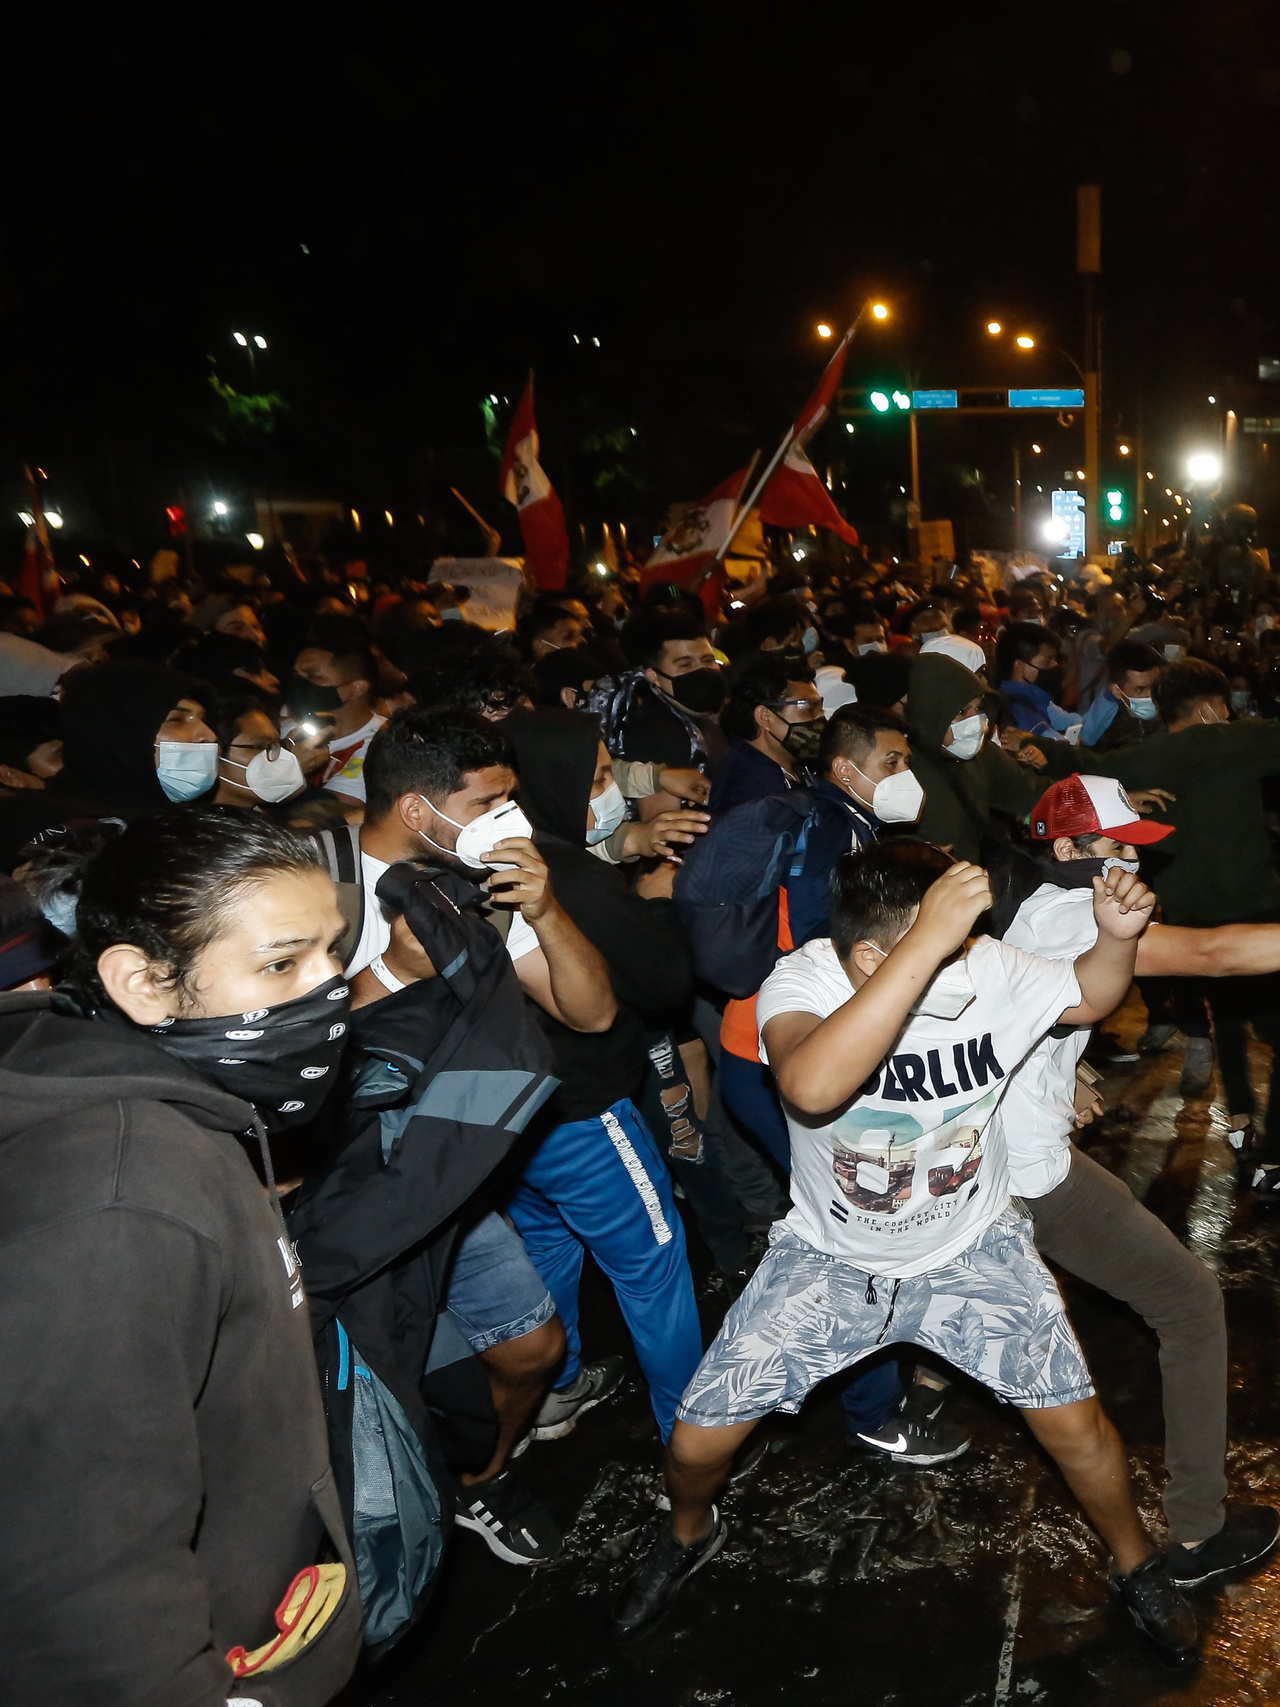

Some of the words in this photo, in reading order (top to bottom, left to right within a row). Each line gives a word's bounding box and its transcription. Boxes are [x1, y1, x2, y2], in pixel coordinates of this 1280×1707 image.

[856, 1215, 878, 1226] THE
[884, 1210, 930, 1228] COOLEST
[934, 1199, 959, 1211] CITY
[889, 1224, 910, 1234] THE
[916, 1210, 951, 1227] WORLD
